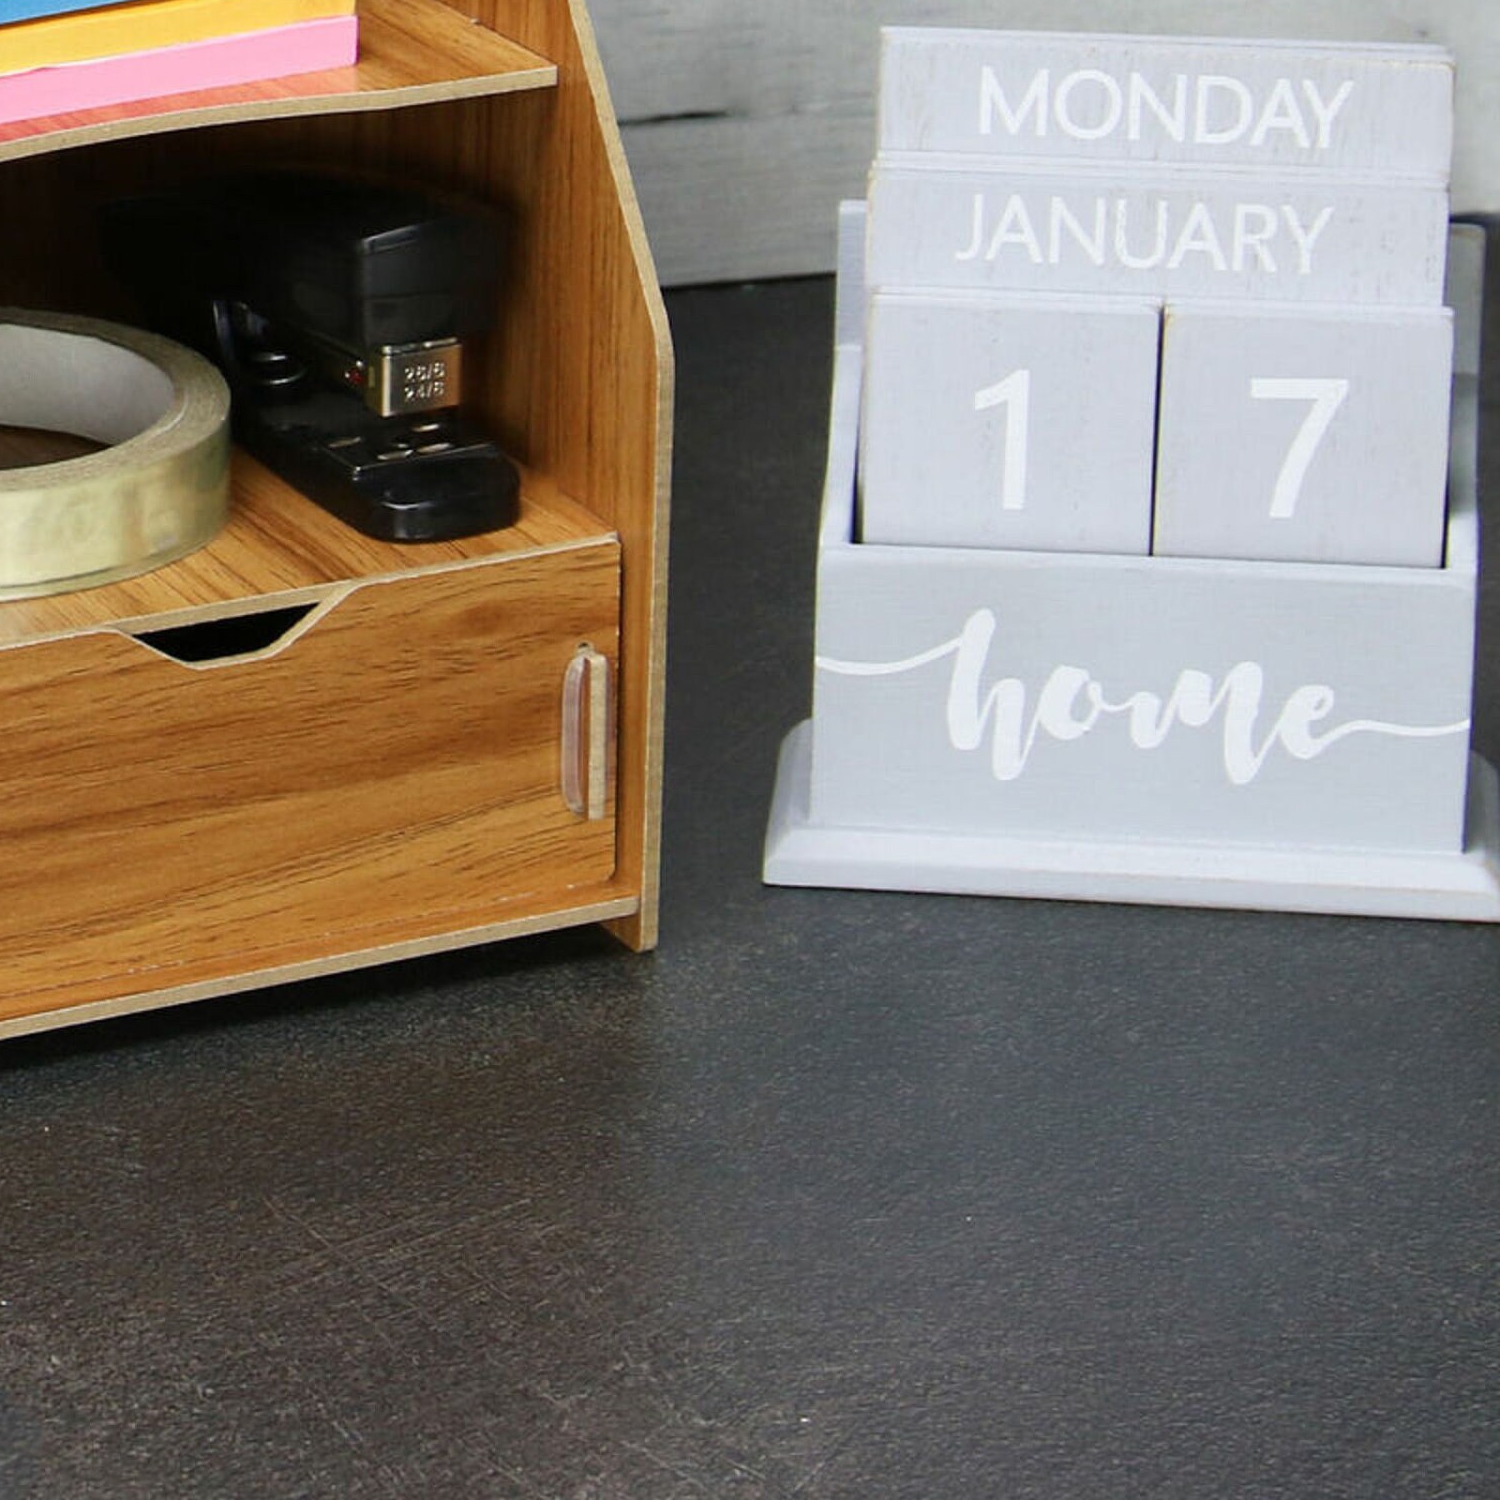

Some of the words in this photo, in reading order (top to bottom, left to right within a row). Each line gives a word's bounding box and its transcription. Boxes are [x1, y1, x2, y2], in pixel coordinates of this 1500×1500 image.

[978, 65, 1355, 150] MONDAY
[954, 193, 1335, 275] JANUARY
[815, 608, 1471, 785] home
